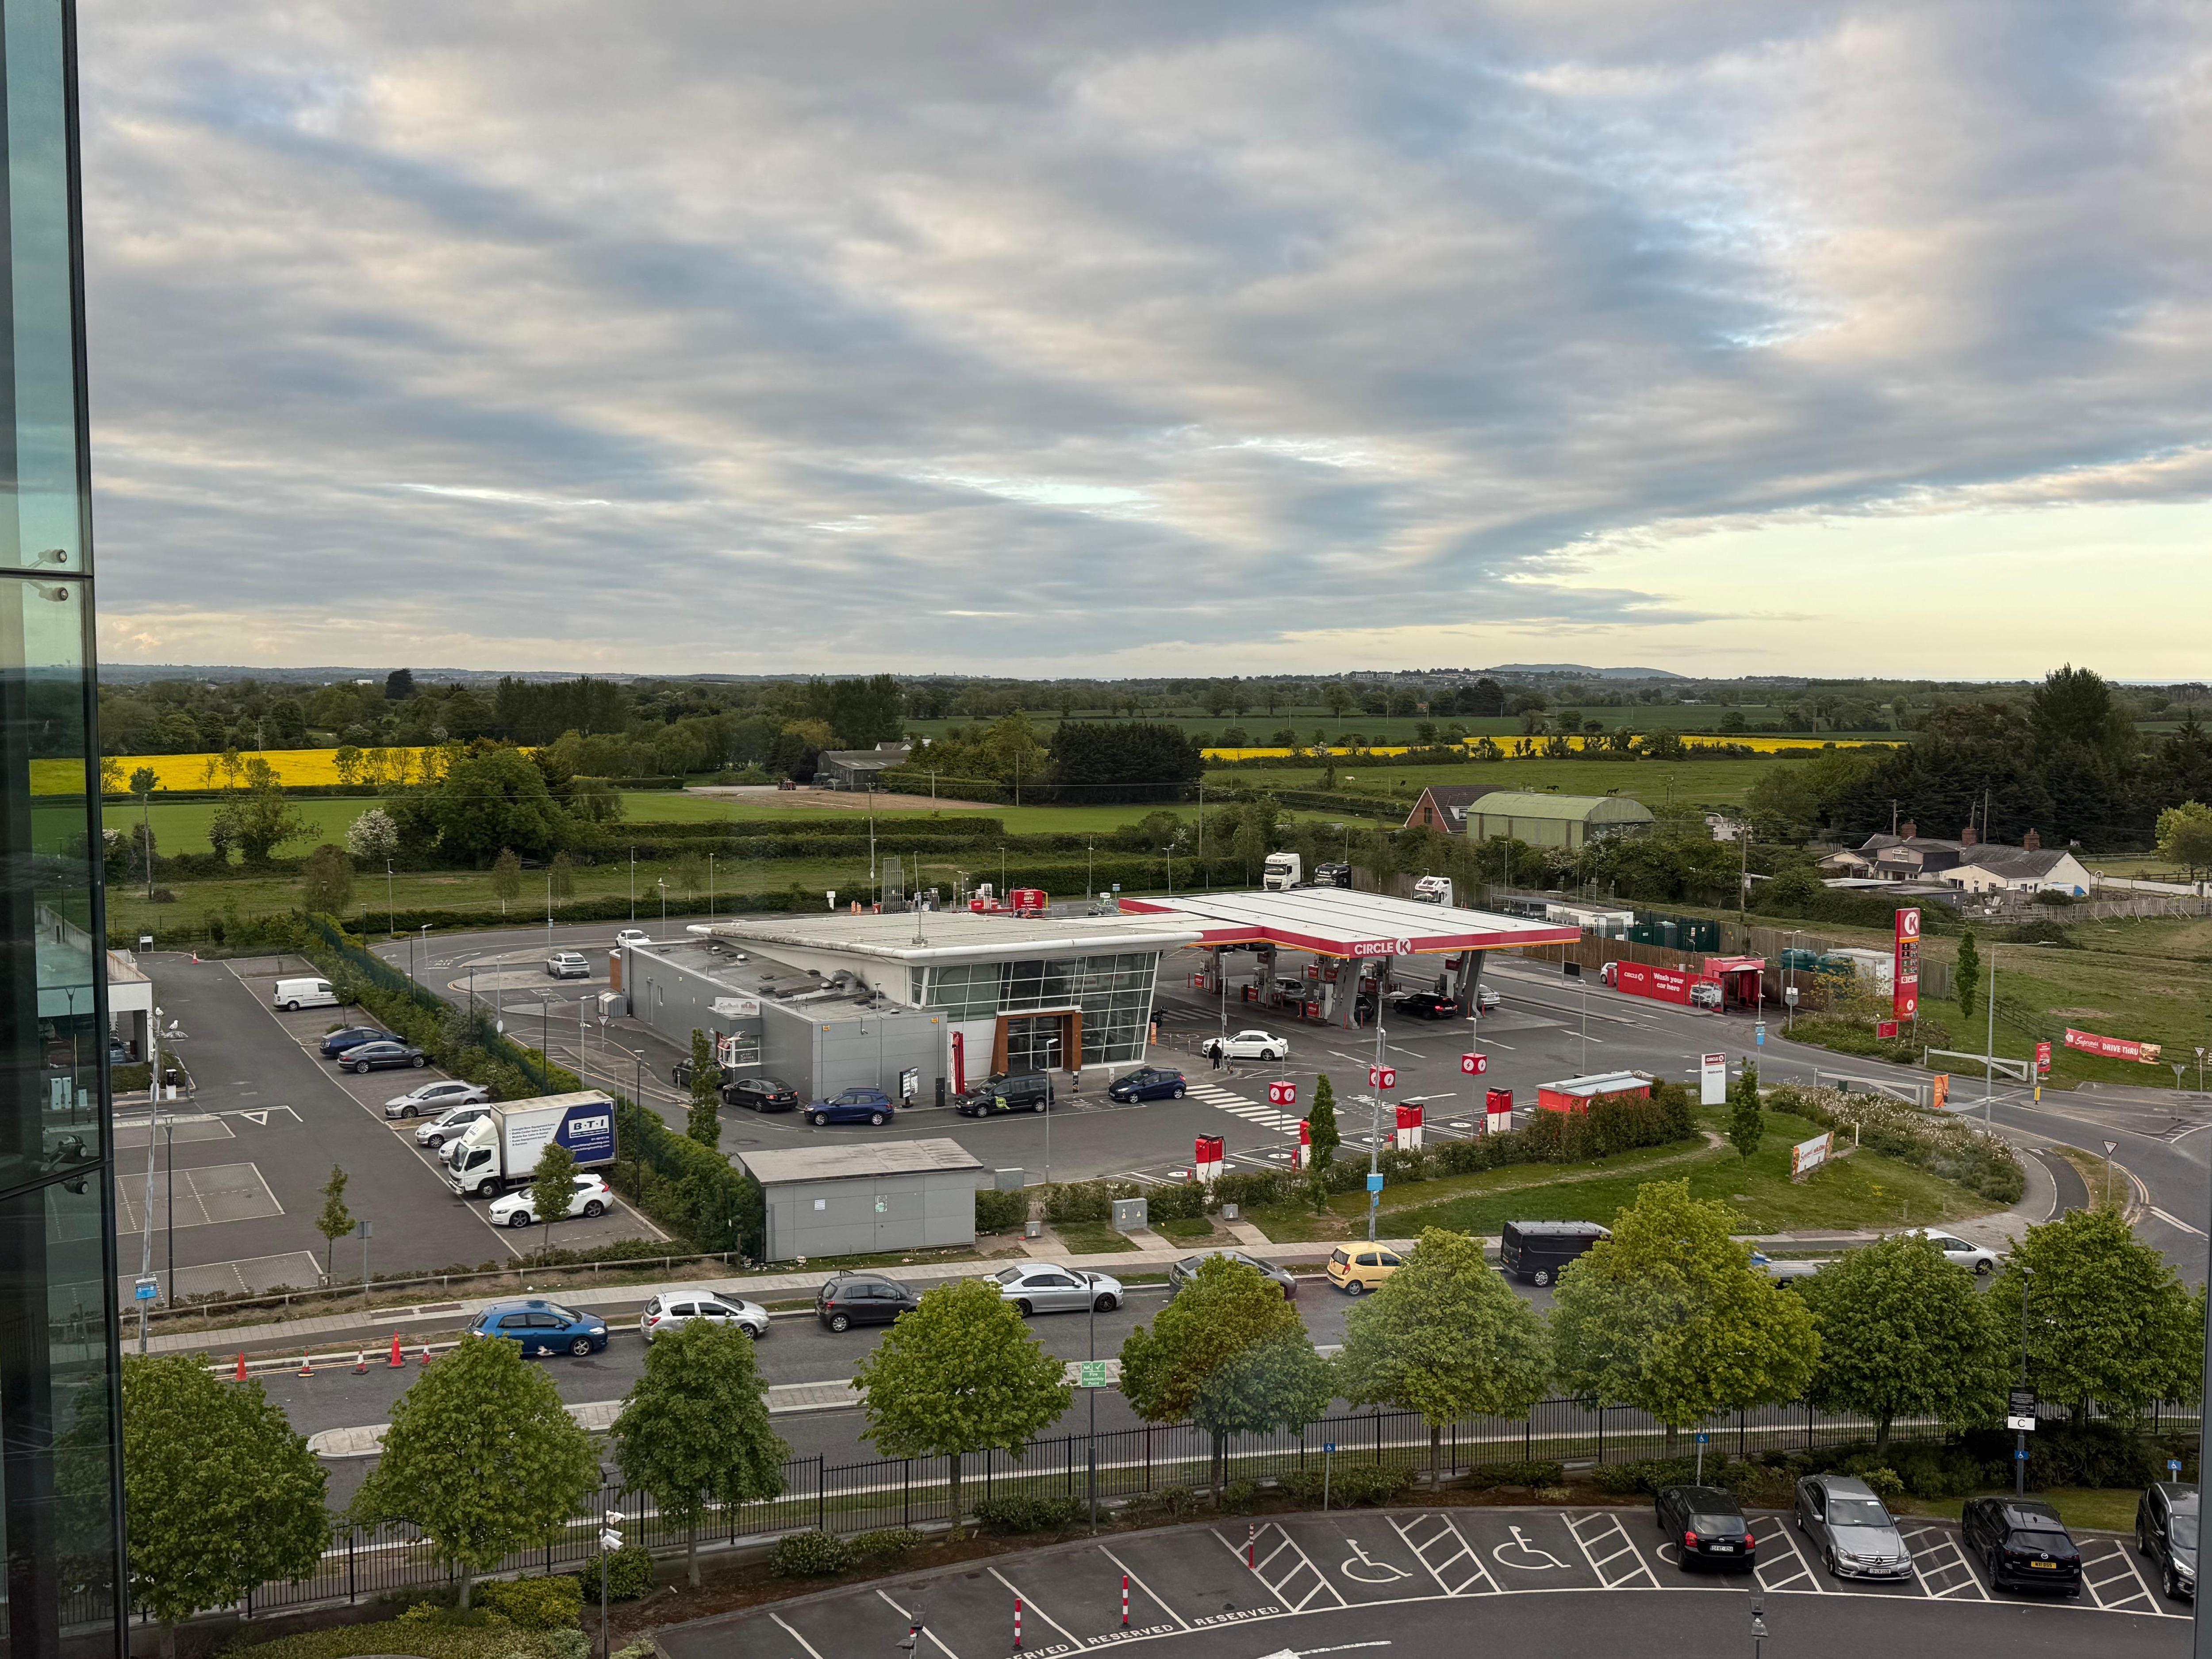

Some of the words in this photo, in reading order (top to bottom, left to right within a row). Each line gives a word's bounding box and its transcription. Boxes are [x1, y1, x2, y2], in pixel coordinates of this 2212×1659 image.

[1906, 914, 1918, 933] K
[1354, 942, 1393, 955] CIRCLE
[1398, 939, 1411, 954] K
[1653, 972, 1669, 981] Wash
[2102, 1043, 2121, 1052] DRIVE
[2122, 1046, 2139, 1056] THRU
[1194, 1607, 1279, 1625] RESERVED
[1087, 1625, 1174, 1645] RESERVED
